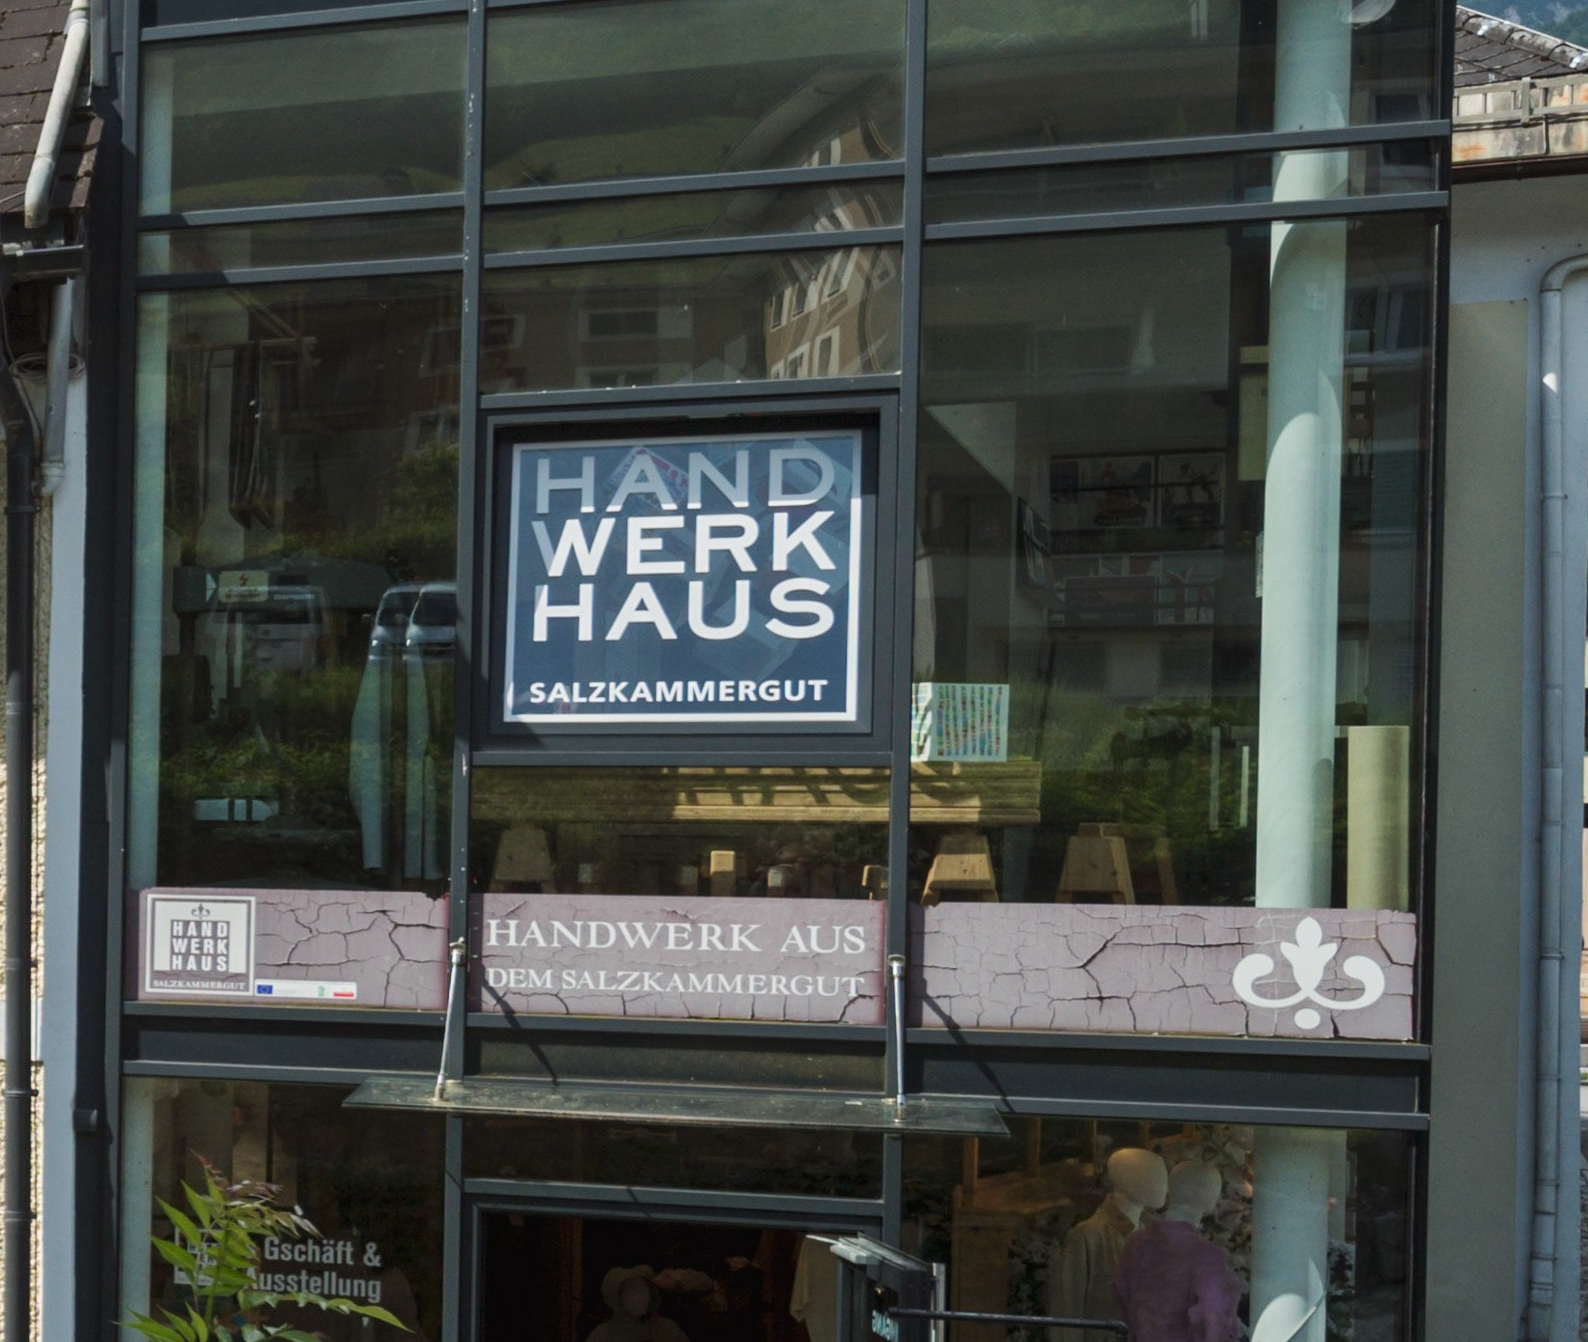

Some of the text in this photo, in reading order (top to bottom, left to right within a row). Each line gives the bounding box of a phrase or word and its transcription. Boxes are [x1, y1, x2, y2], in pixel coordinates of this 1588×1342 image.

[536, 447, 836, 514] HAND
[531, 510, 837, 577] WERK
[532, 577, 836, 642] HAUS
[529, 678, 829, 704] SALZKAMMERGUT
[172, 920, 229, 937] HAND
[487, 919, 866, 955] HANDWERK AUS
[172, 938, 229, 954] WERK
[172, 955, 229, 971] HAUS
[152, 980, 246, 990] SALZKAMMERGUT
[487, 967, 865, 997] DEM SALZKAMMERGUT
[264, 1236, 382, 1267] Gschäft &
